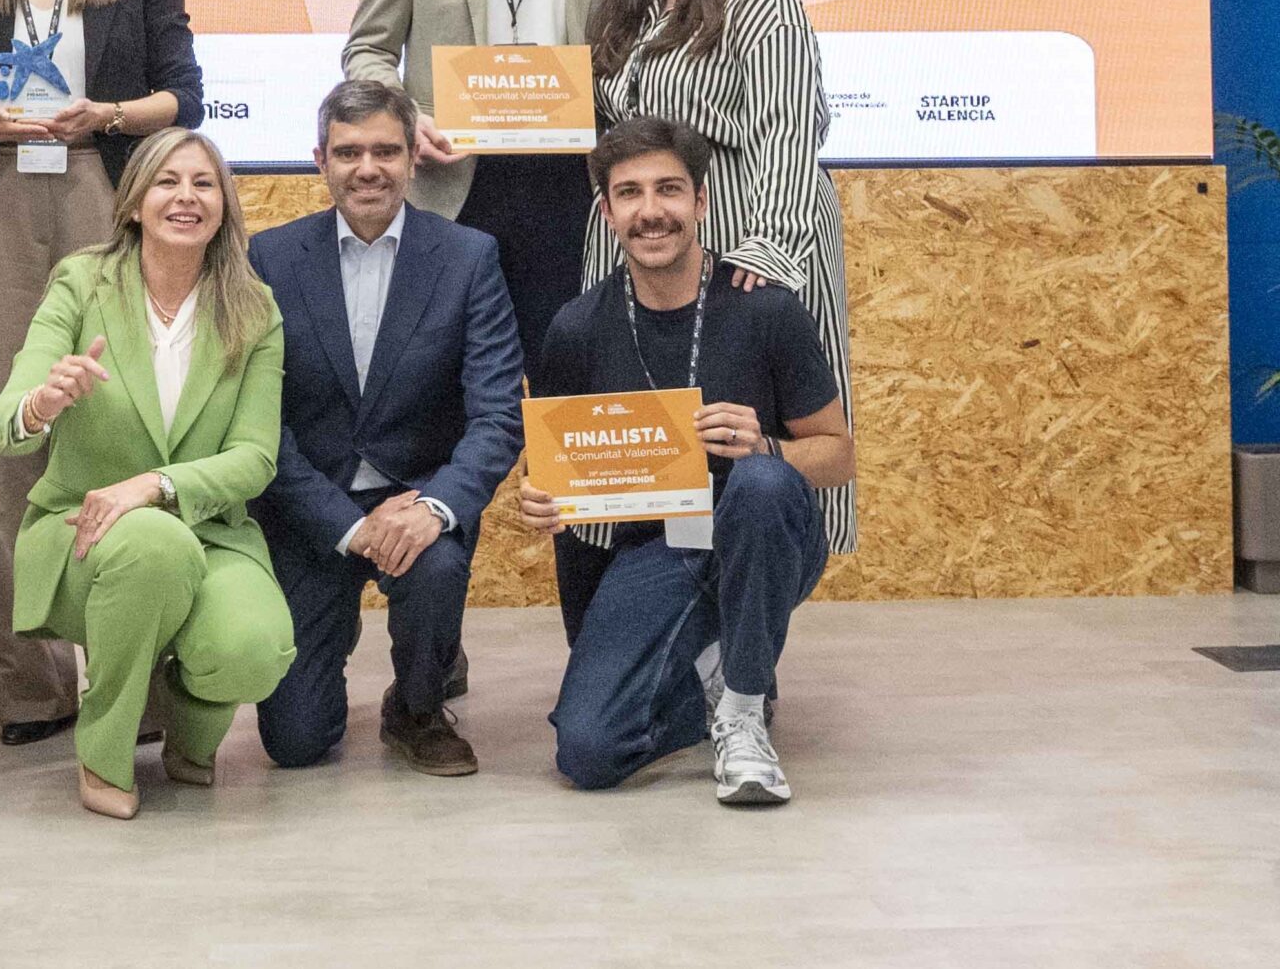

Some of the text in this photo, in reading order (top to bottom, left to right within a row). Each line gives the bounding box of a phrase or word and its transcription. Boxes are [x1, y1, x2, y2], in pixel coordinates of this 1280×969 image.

[467, 74, 561, 89] FINALISTA
[459, 91, 570, 101] de Comunitat Valenciana
[920, 95, 991, 108] STARTUP
[203, 99, 249, 120] nisa
[916, 109, 996, 121] VALENCIA
[563, 426, 669, 448] FINALISTA
[554, 446, 680, 463] de Comunitat Valenciana
[569, 478, 608, 488] PREMIOS
